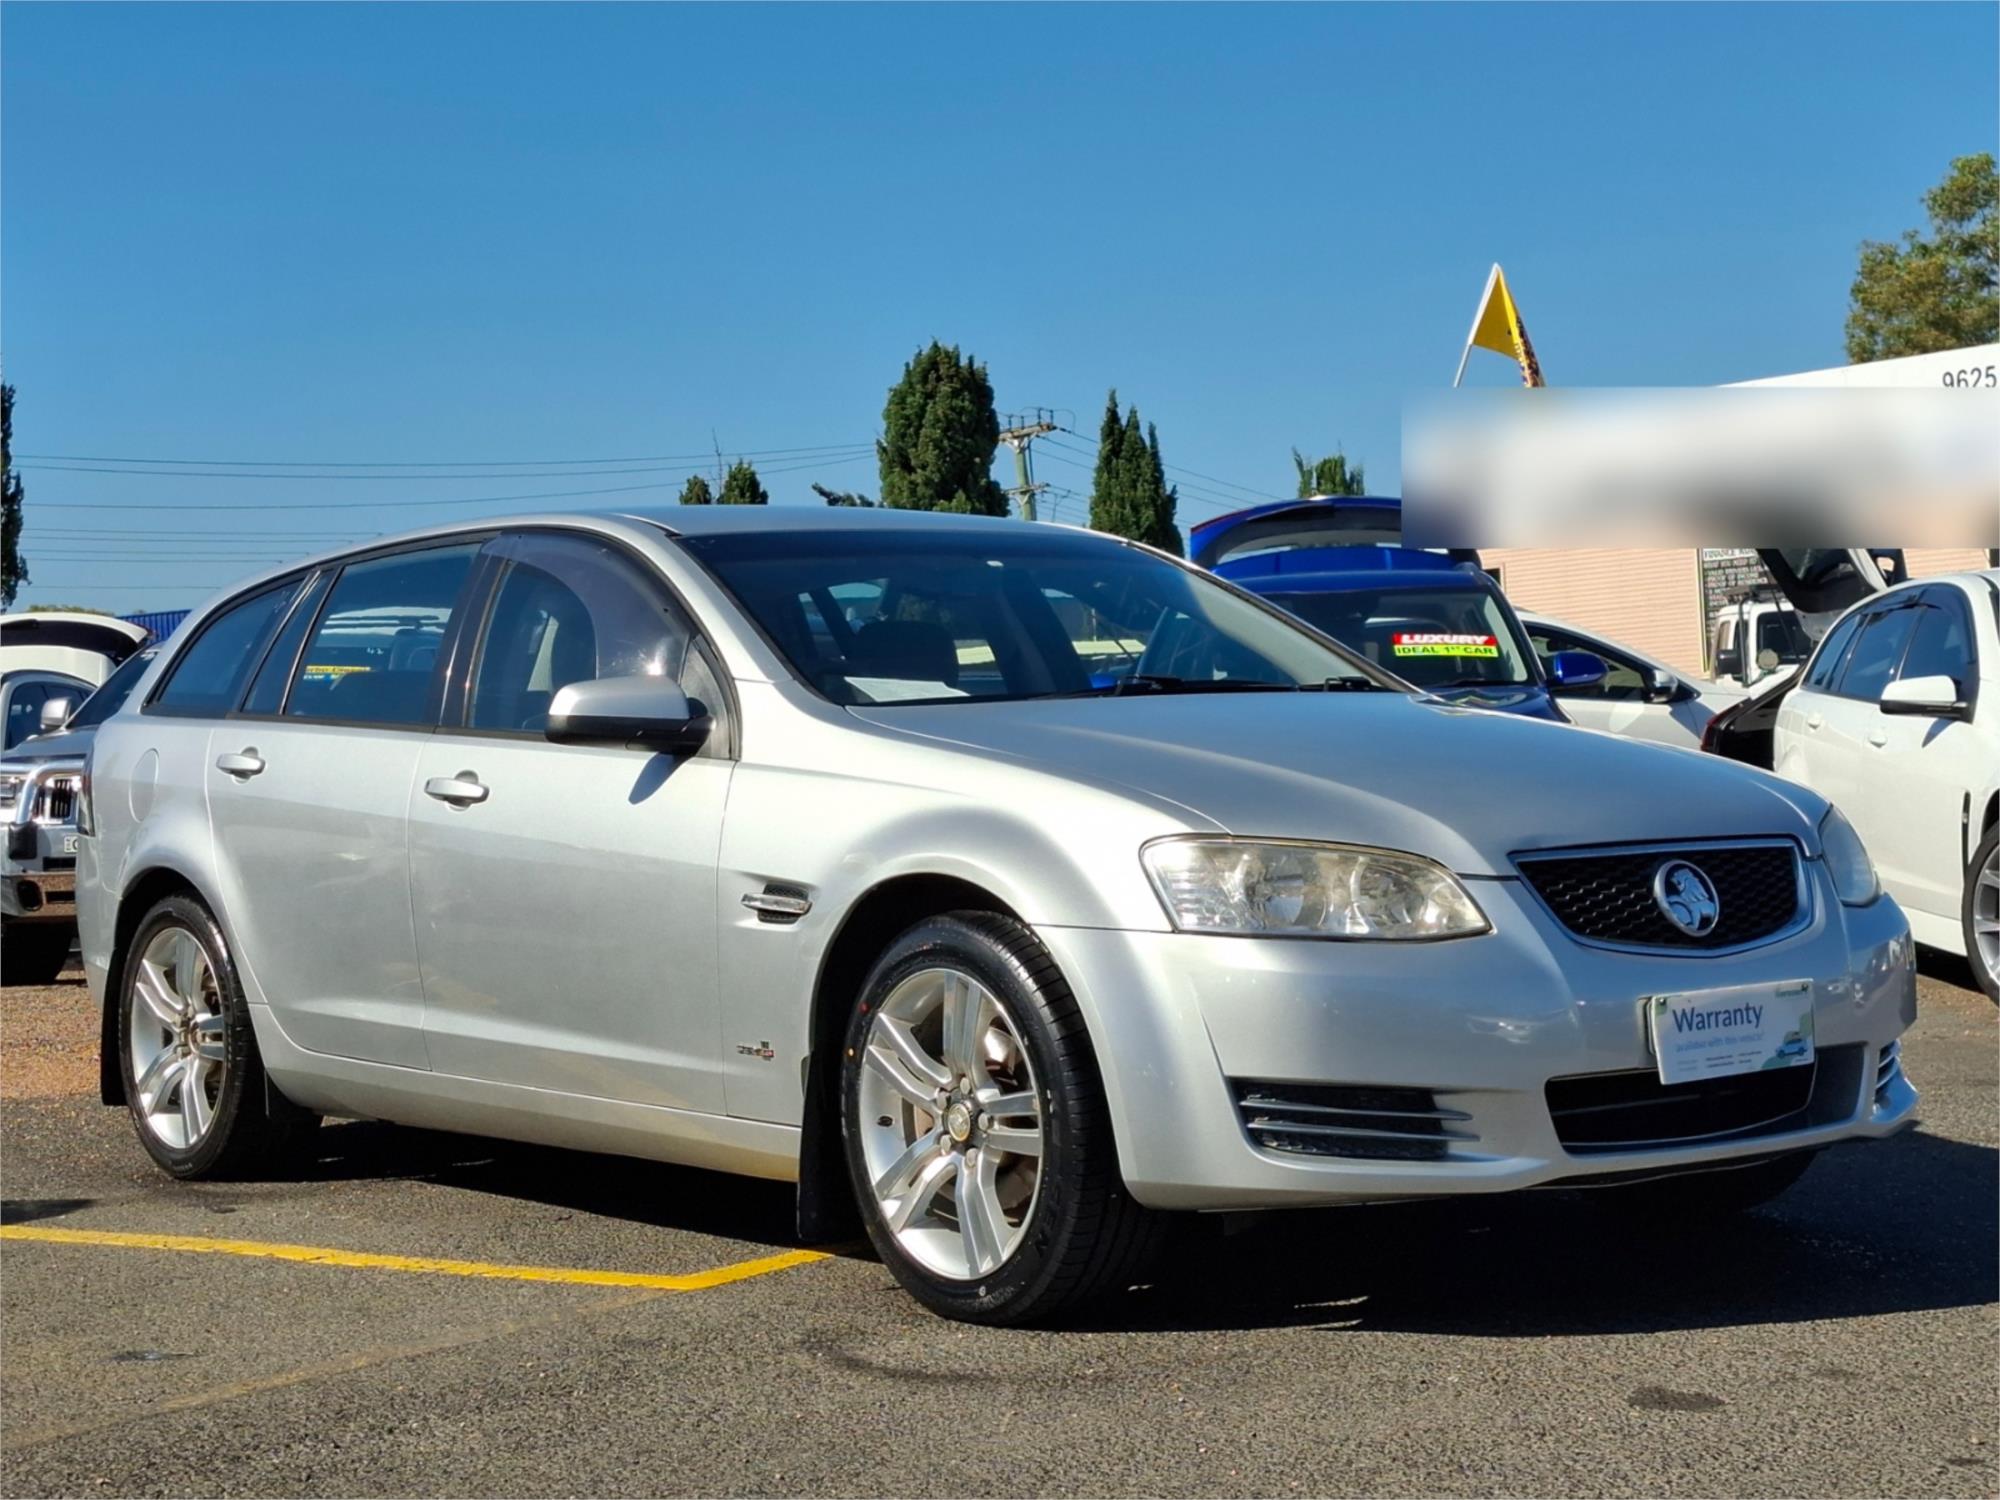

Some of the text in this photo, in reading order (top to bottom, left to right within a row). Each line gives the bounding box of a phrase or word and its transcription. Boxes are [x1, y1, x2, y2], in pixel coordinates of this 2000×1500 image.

[1942, 364, 1997, 388] 9625
[1401, 633, 1489, 645] LUXURY
[1396, 645, 1439, 654] IDEAL
[1463, 646, 1494, 655] CAR
[1672, 1002, 1763, 1033] Warranty
